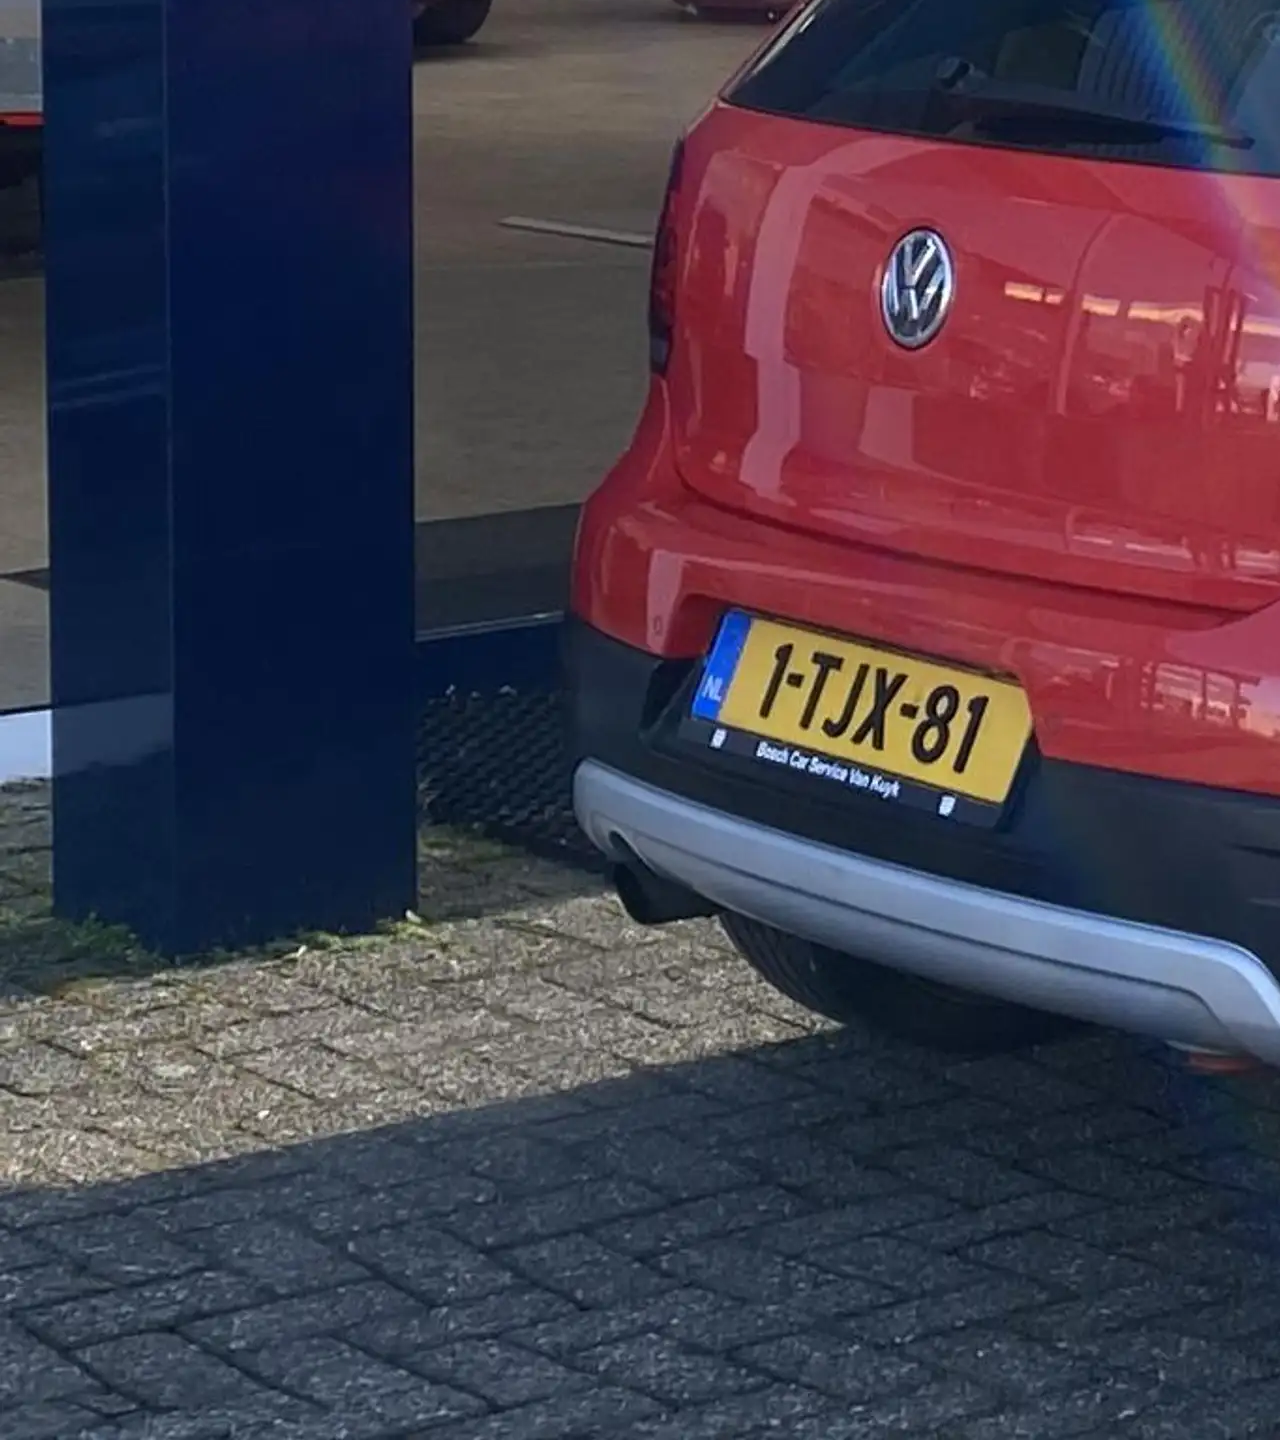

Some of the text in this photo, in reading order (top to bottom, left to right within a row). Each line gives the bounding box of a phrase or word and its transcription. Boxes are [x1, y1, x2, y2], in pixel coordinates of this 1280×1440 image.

[702, 676, 722, 702] NL
[759, 643, 989, 773] 1-TJX-81
[756, 741, 788, 764] Bosch
[790, 751, 809, 770] Car
[809, 757, 848, 781] Service
[850, 768, 870, 787] Van
